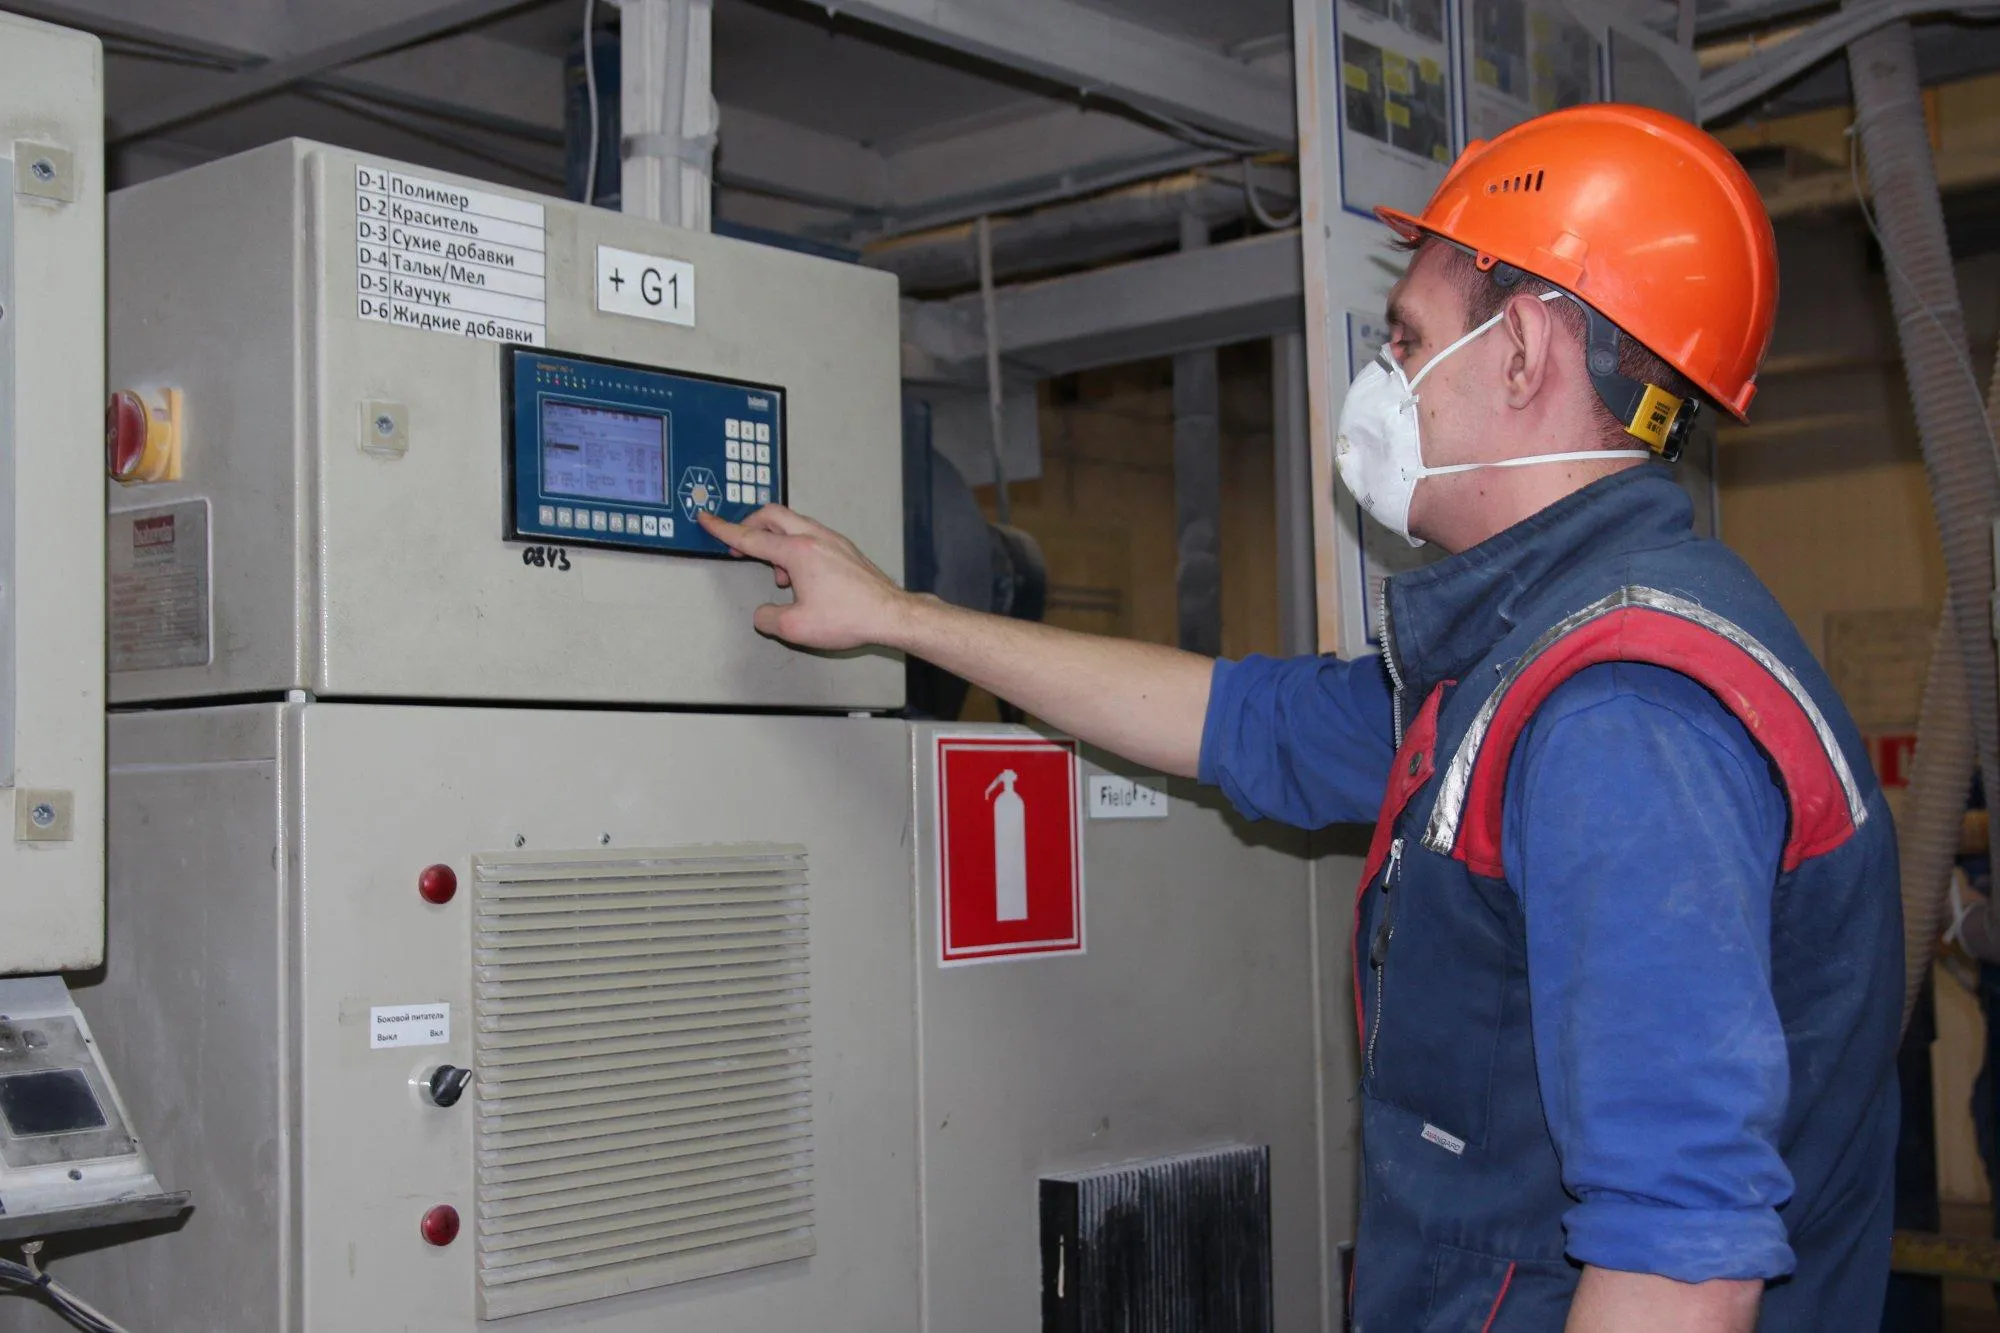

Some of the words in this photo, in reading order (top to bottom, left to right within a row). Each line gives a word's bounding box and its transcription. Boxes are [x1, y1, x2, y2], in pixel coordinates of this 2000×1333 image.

[359, 170, 386, 191] D-1
[392, 177, 468, 212] Полимер
[359, 196, 387, 216] D-2
[393, 202, 478, 235] Краситель
[360, 221, 387, 241] D-3
[393, 228, 441, 252] Сухие
[446, 242, 514, 267] добавки
[360, 247, 388, 268] D-4
[392, 252, 485, 286] Тальк/Мел
[360, 273, 388, 293] D-5
[393, 279, 451, 307] Каучук
[641, 267, 677, 310] G1
[360, 299, 389, 319] D-6
[393, 304, 461, 331] Жидкие
[465, 320, 533, 343] добавки
[377, 1013, 410, 1024] Боковой
[411, 1012, 445, 1021] питатель
[377, 1033, 398, 1042] Выкл
[429, 1029, 444, 1038] Вкл
